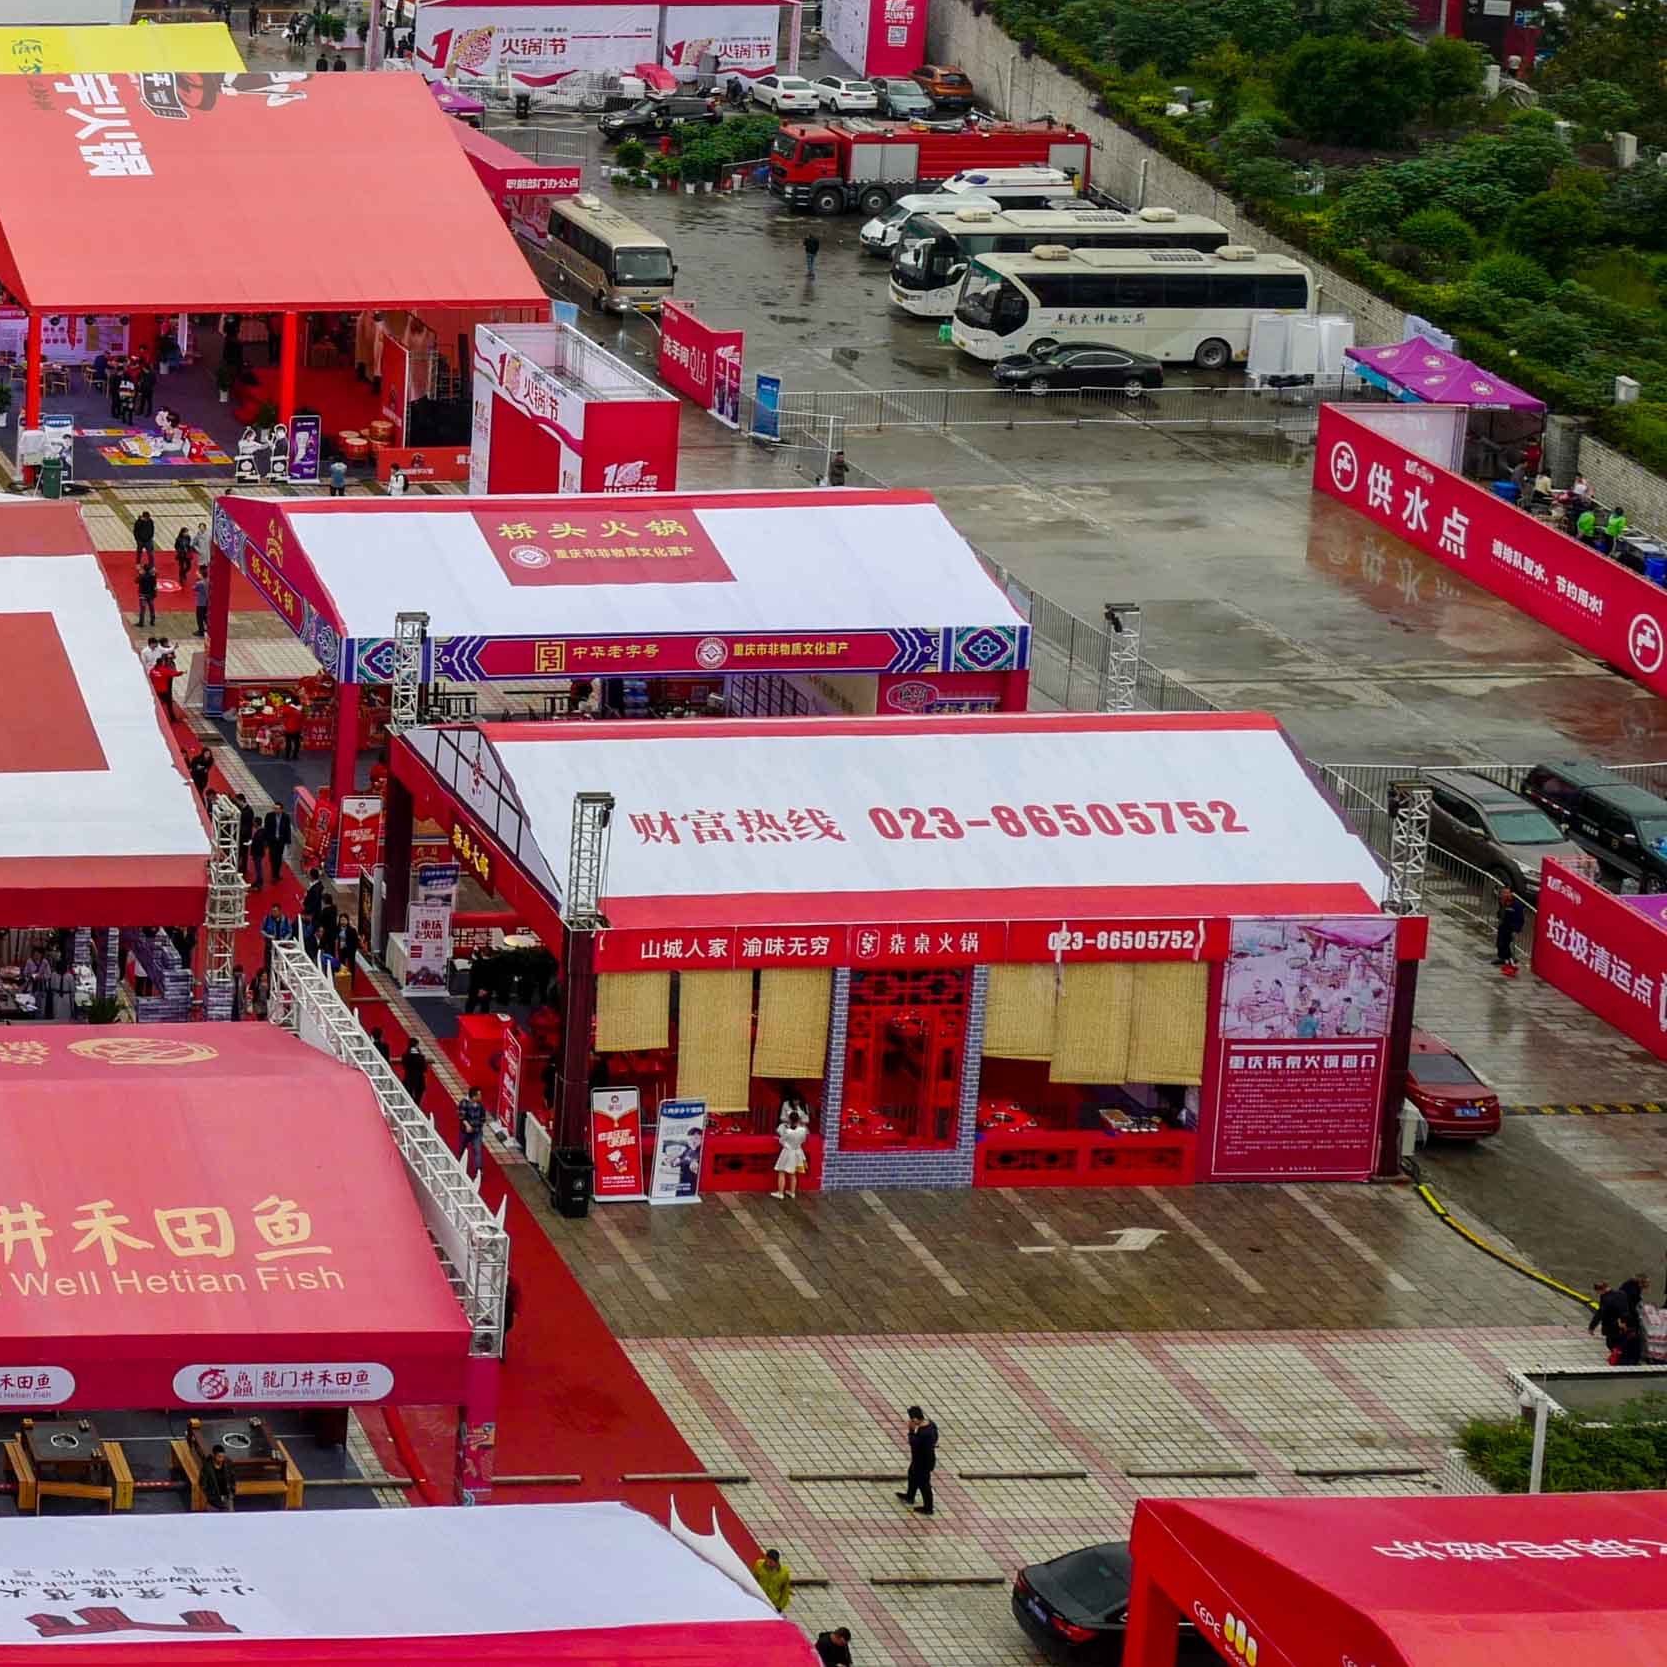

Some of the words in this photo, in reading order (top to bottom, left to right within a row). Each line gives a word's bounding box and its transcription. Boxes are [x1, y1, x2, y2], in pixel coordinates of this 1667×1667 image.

[506, 177, 580, 190] 职能部门办公点
[663, 333, 690, 368] 洗手间
[1367, 461, 1470, 559] 供水点
[498, 518, 688, 541] 桥头火锅
[553, 545, 696, 561] 重庆市非物质文化遗产
[572, 642, 660, 660] 中华老字号
[733, 640, 849, 657] 重庆市非物质文化遗产
[629, 807, 846, 847] 财富热线
[869, 799, 1251, 840] 023-86505752
[640, 936, 729, 962] 山城人家
[740, 933, 831, 959] 渝味无穷
[1047, 928, 1196, 952] 023-86505752
[1546, 913, 1655, 1008] 垃圾清运点
[9, 1267, 101, 1297] Well
[122, 1266, 249, 1296] Hetian
[258, 1263, 346, 1293] Fish
